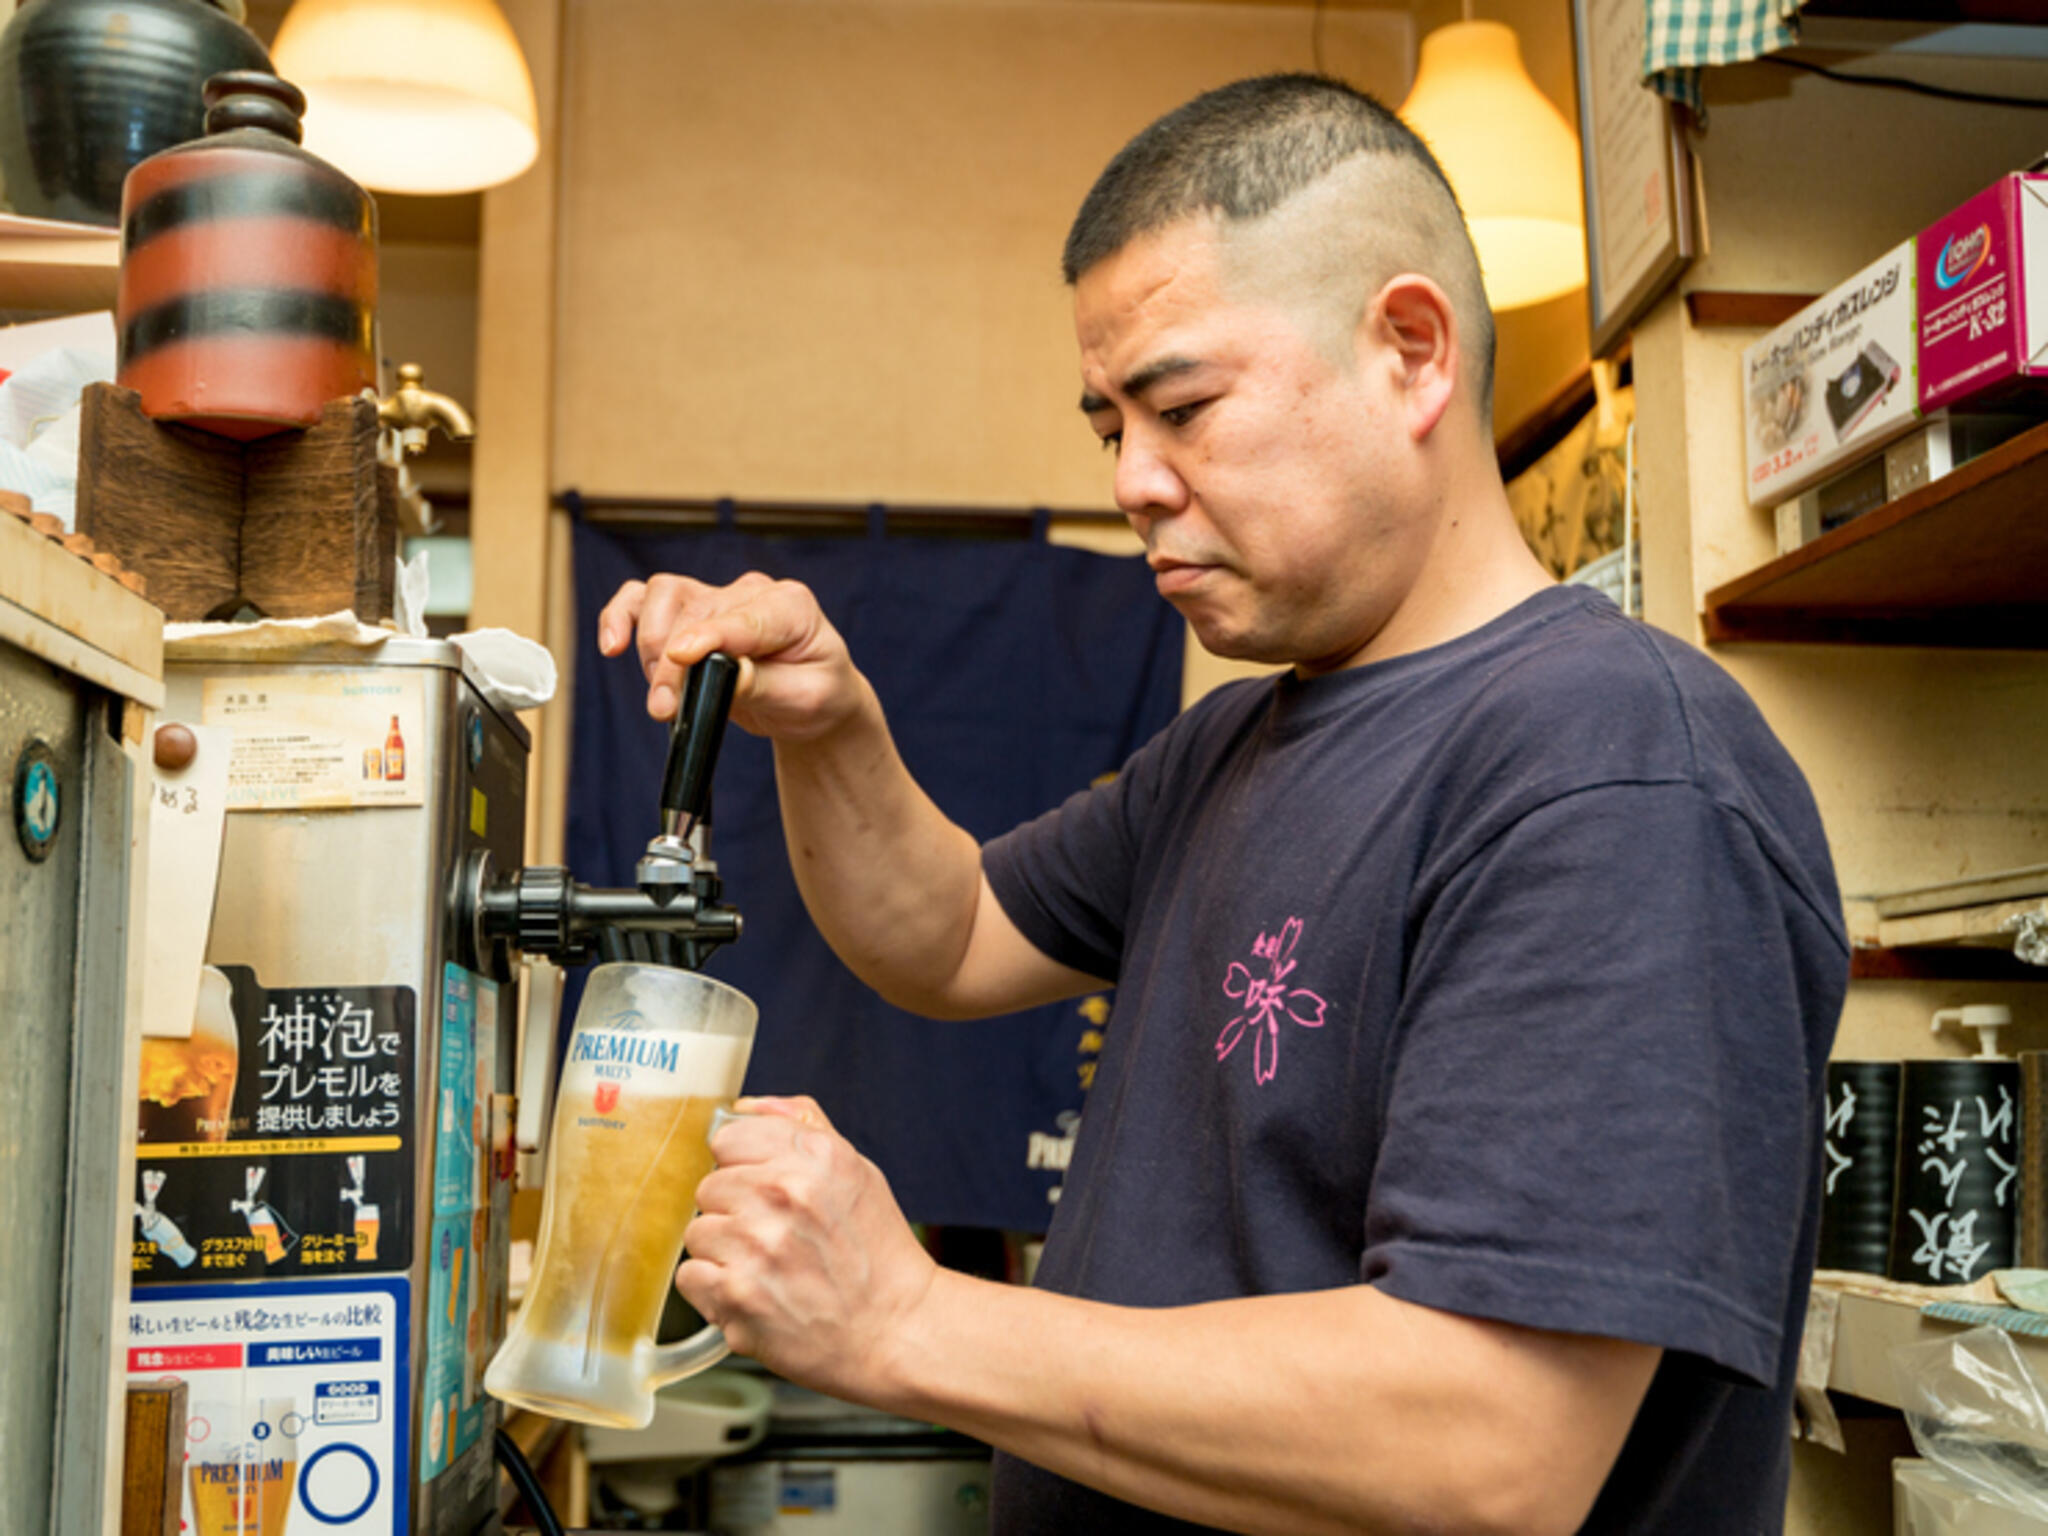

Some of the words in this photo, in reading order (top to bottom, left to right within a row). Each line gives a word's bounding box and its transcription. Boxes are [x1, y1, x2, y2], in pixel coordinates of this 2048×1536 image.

[258, 1000, 401, 1063] 神泡で
[571, 1032, 680, 1073] PREMIUM
[259, 1063, 401, 1100] プレモルを
[256, 1101, 401, 1133] 提供しましょう
